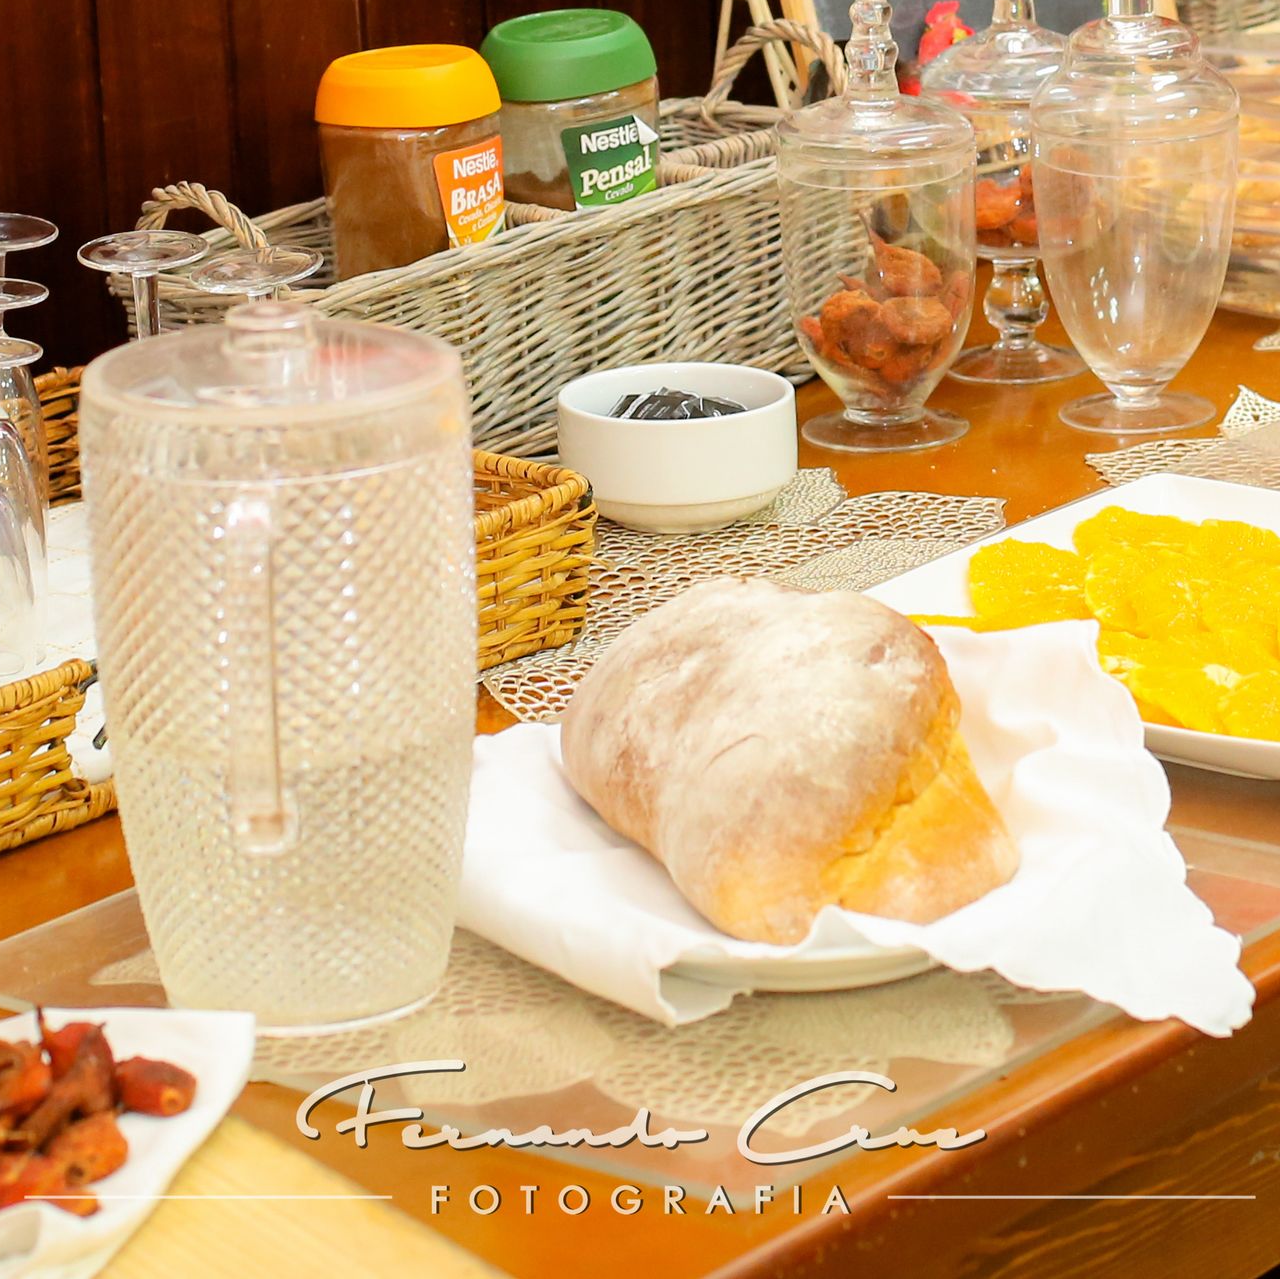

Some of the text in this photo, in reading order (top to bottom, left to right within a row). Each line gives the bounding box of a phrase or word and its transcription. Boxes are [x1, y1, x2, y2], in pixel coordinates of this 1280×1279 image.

[580, 123, 639, 154] Nestlé
[453, 148, 497, 179] Nestlé
[580, 145, 652, 197] Pensal
[451, 171, 501, 216] BRASA
